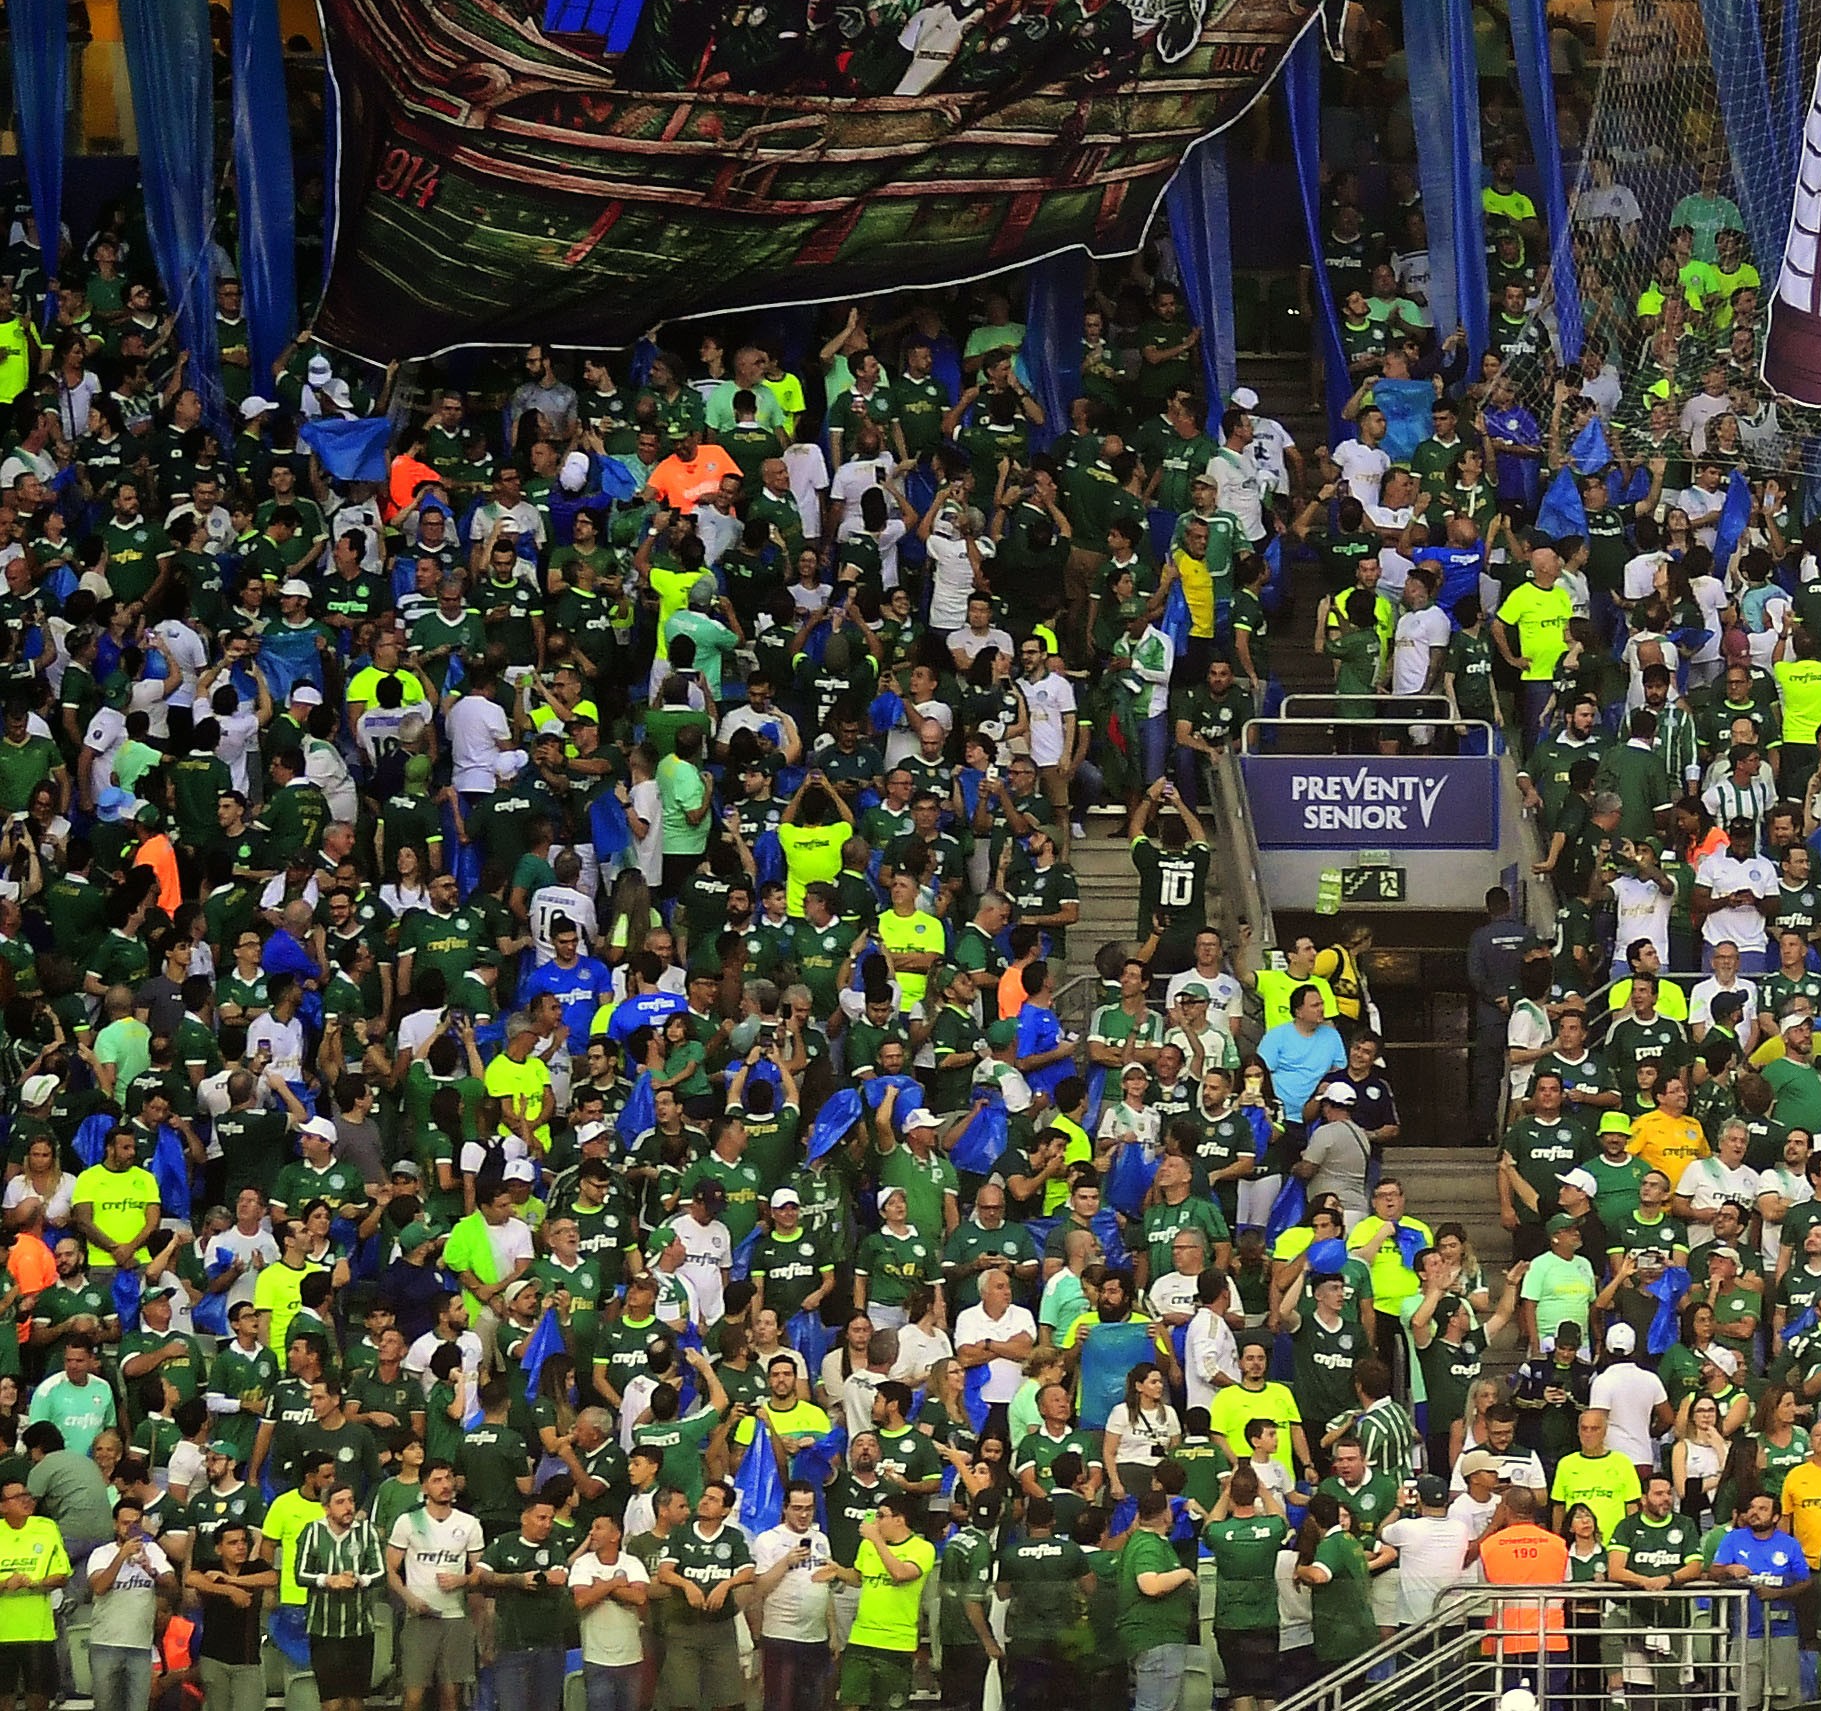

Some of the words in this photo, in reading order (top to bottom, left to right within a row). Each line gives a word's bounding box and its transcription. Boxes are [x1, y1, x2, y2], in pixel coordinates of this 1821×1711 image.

[1292, 767, 1420, 801] PREVENT
[1303, 805, 1408, 830] SENIOR
[1160, 867, 1194, 905] 10
[1775, 914, 1812, 928] crefisa
[1530, 1146, 1573, 1161] crefisa
[102, 1198, 144, 1212] crefisa
[579, 1235, 617, 1251] crefisa
[685, 1253, 722, 1266] crefisa
[770, 1263, 812, 1279] crefisa
[1314, 1353, 1351, 1368] crefisa
[1175, 1446, 1214, 1459] crefisa
[1018, 1543, 1061, 1559] crefisa
[1513, 1548, 1536, 1558] 190
[1635, 1550, 1679, 1567] crefisa
[1, 1558, 37, 1567] CASE
[685, 1563, 731, 1580] crefisa
